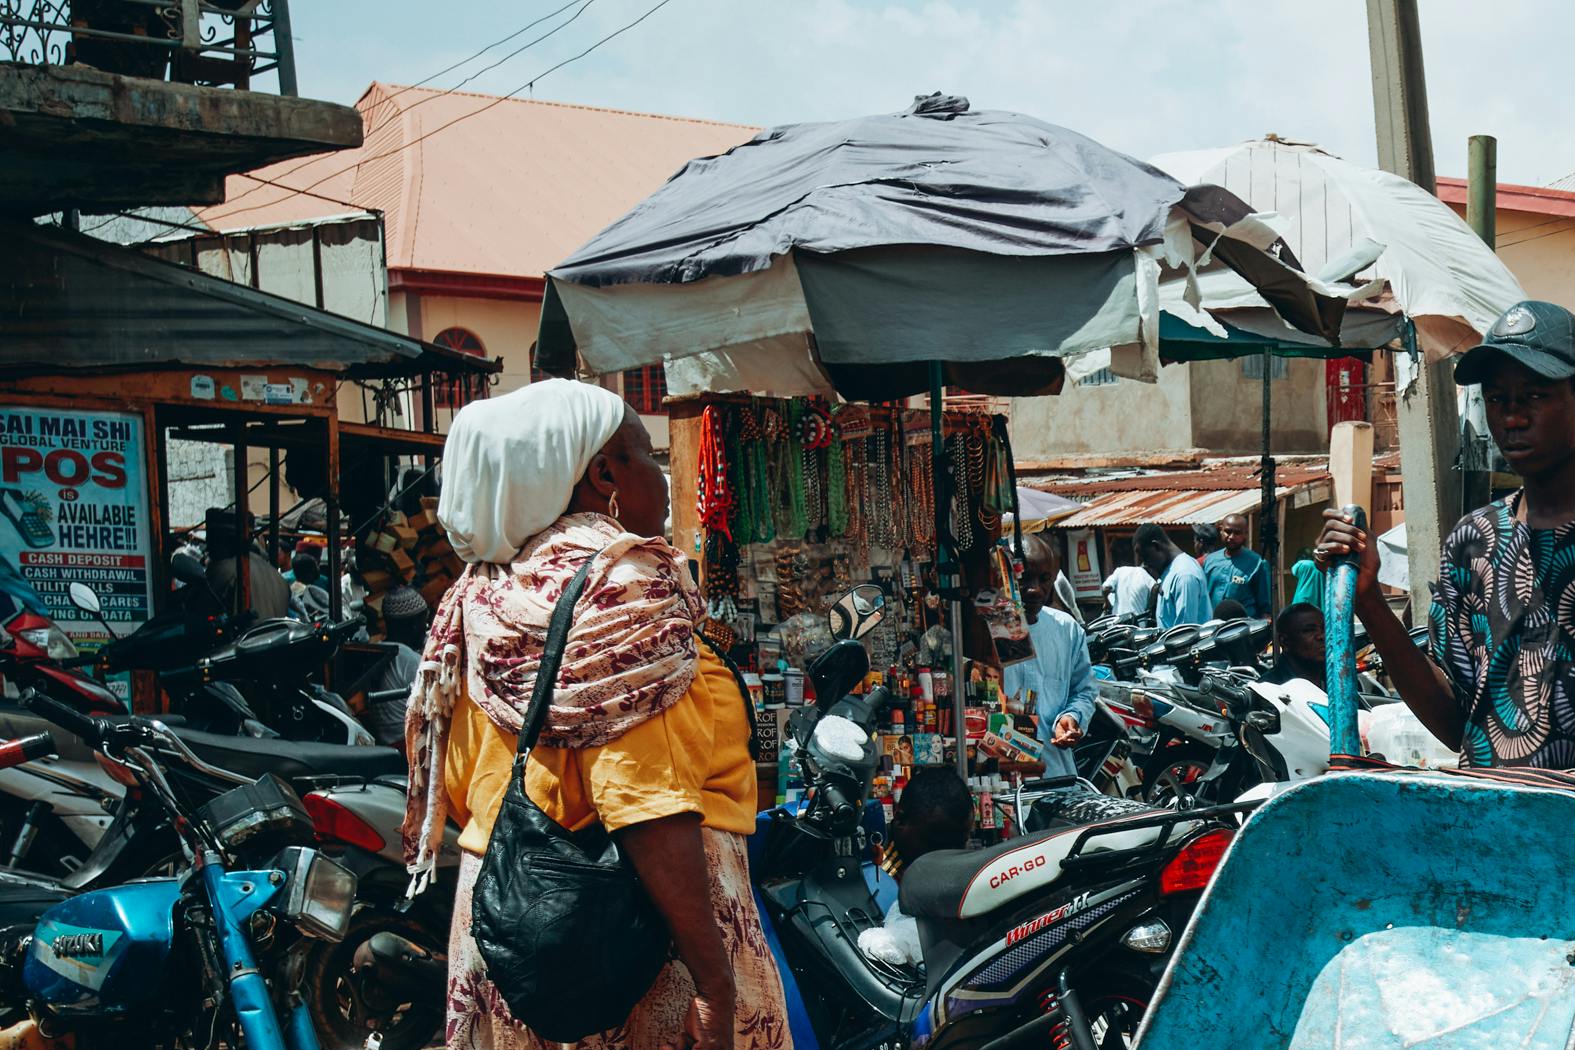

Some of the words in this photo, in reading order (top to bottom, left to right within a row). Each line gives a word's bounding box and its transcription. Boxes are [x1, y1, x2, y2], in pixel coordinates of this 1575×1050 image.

[40, 416, 86, 438] MAI
[93, 420, 130, 441] SHI
[0, 434, 56, 448] GLOBAL
[60, 438, 126, 452] VENTURE
[2, 446, 128, 490] POS
[28, 553, 63, 565] CASH
[67, 556, 122, 566] DEPOSIT
[25, 567, 57, 579] CASH
[101, 611, 132, 621] DATA
